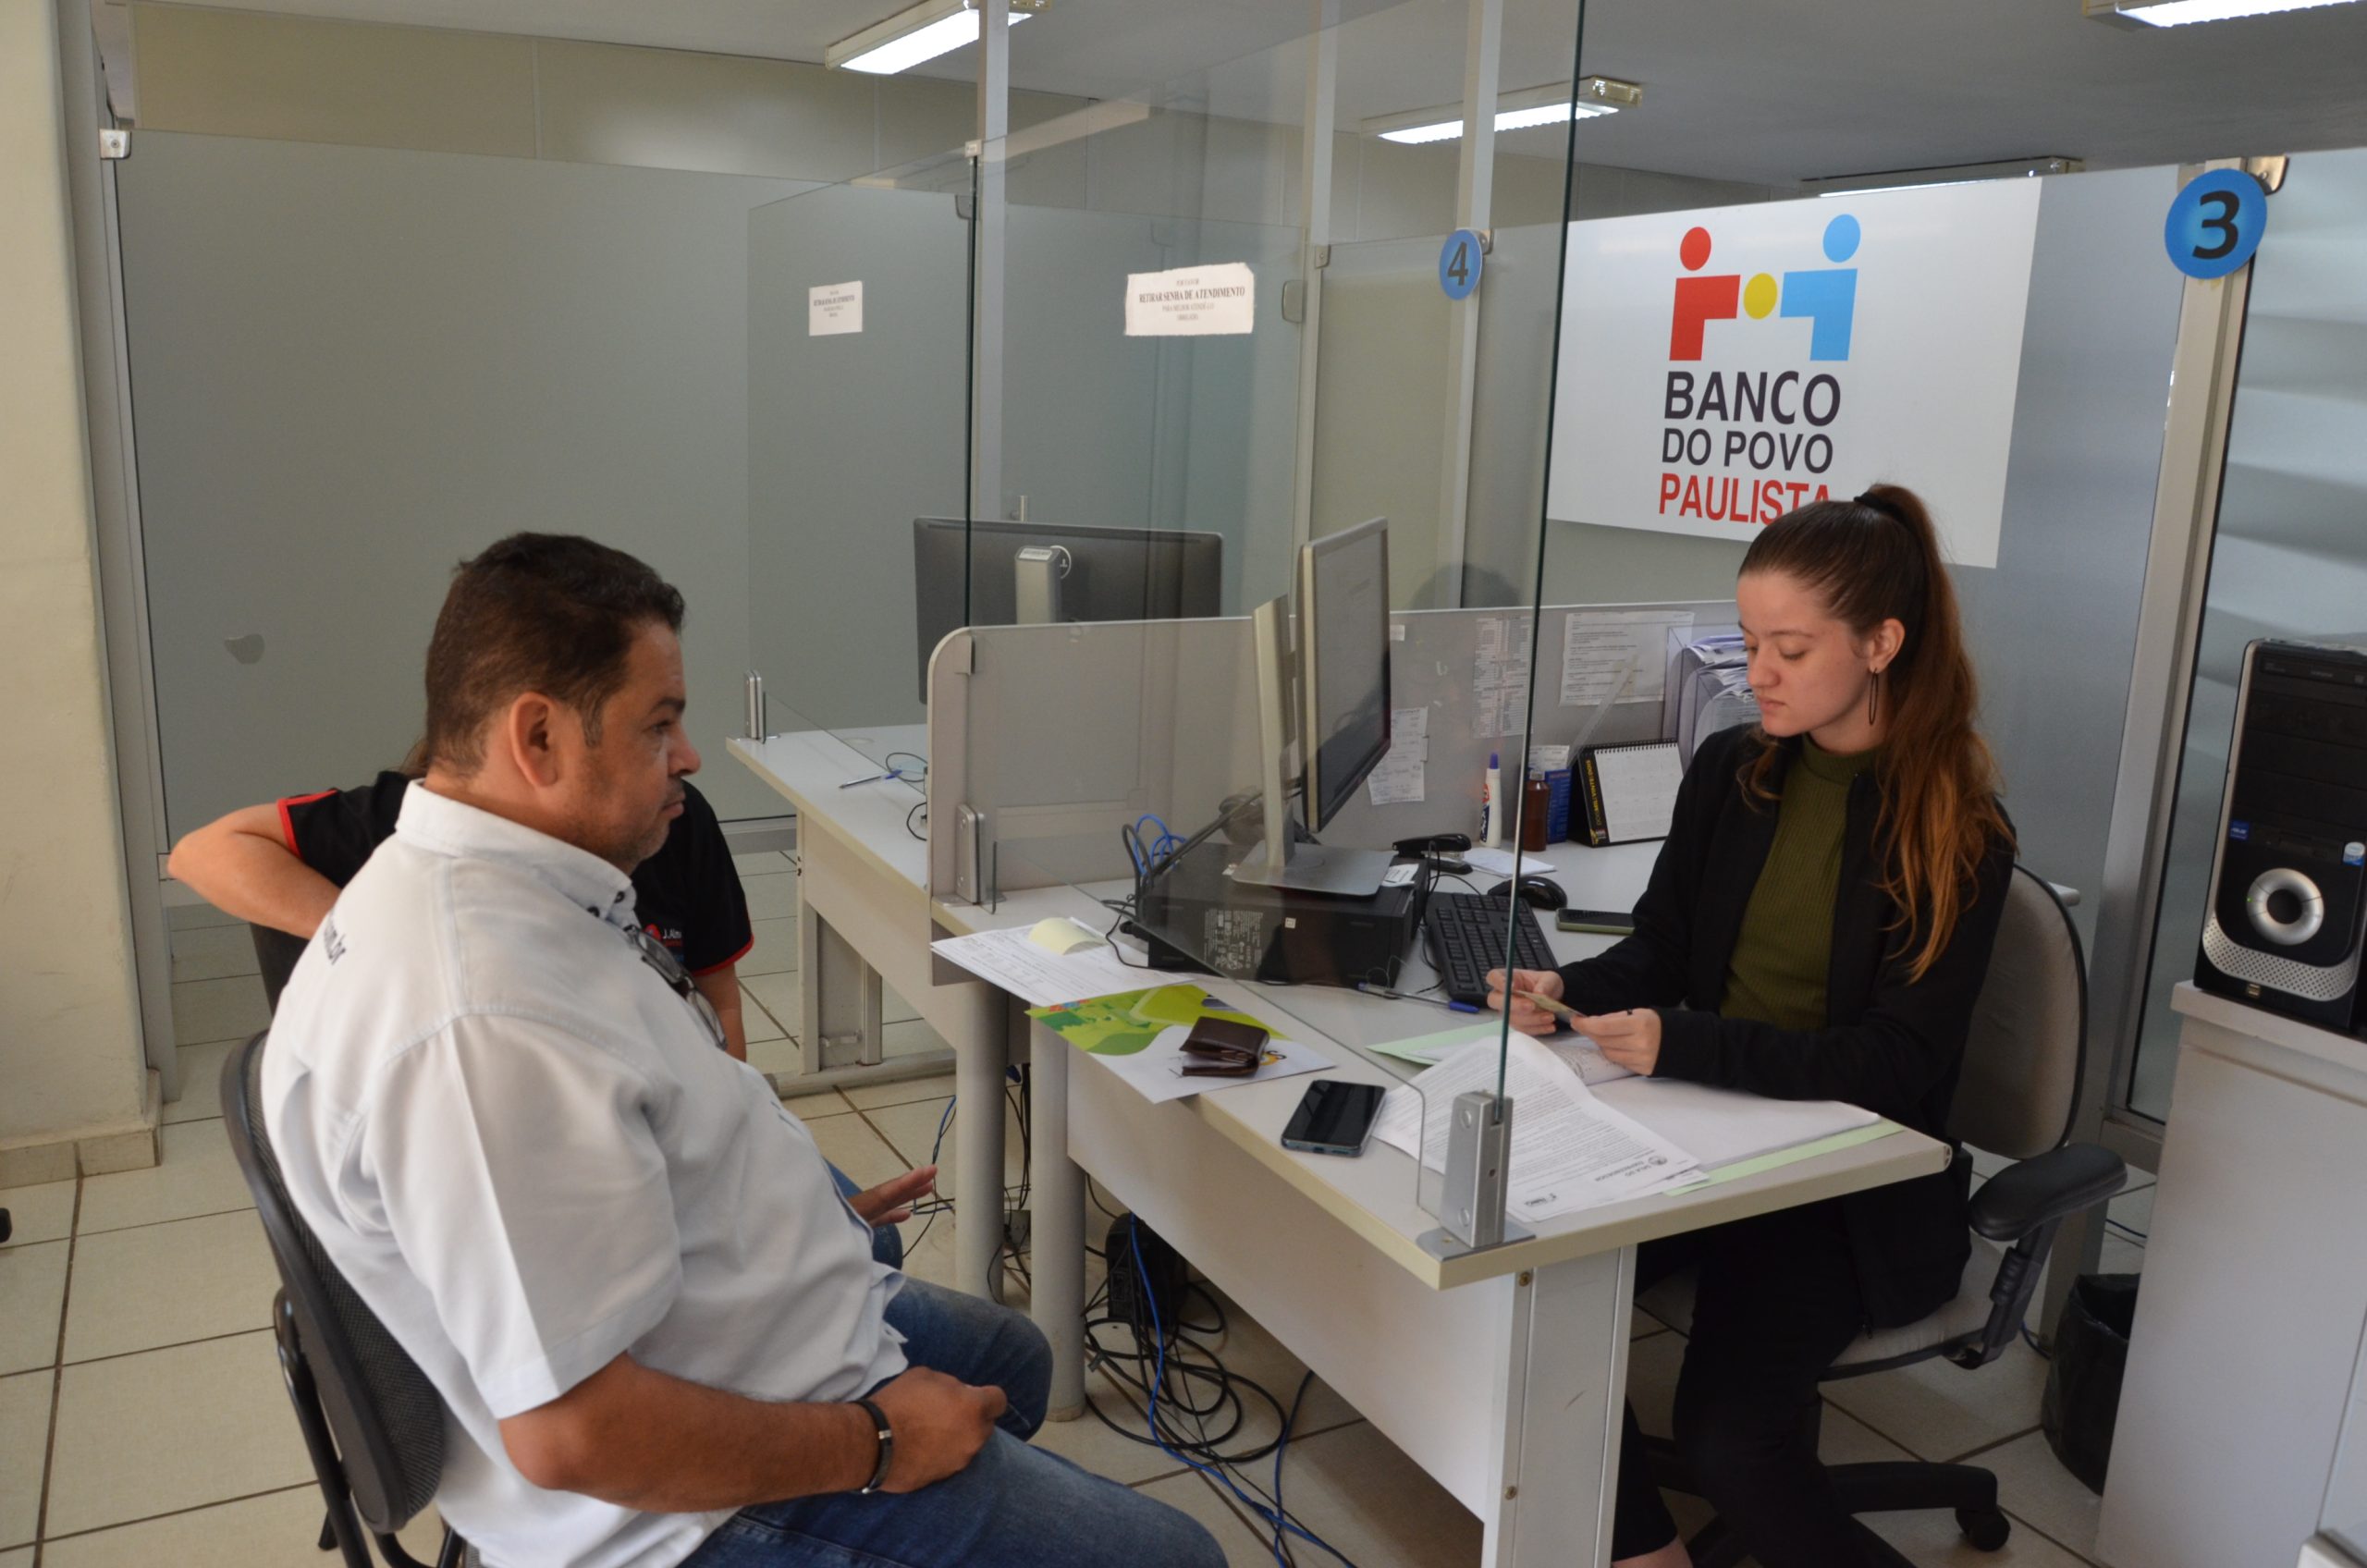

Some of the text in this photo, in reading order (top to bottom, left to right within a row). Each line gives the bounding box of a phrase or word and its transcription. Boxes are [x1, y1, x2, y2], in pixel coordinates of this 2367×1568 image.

[2192, 190, 2240, 260] 3
[1447, 241, 1469, 286] 4
[1163, 291, 1184, 301] SENHA
[1184, 289, 1193, 300] DE
[1196, 287, 1245, 300] ATENDIMENTO
[1664, 370, 1841, 427] BANCO
[1662, 427, 1834, 474] DO POVO
